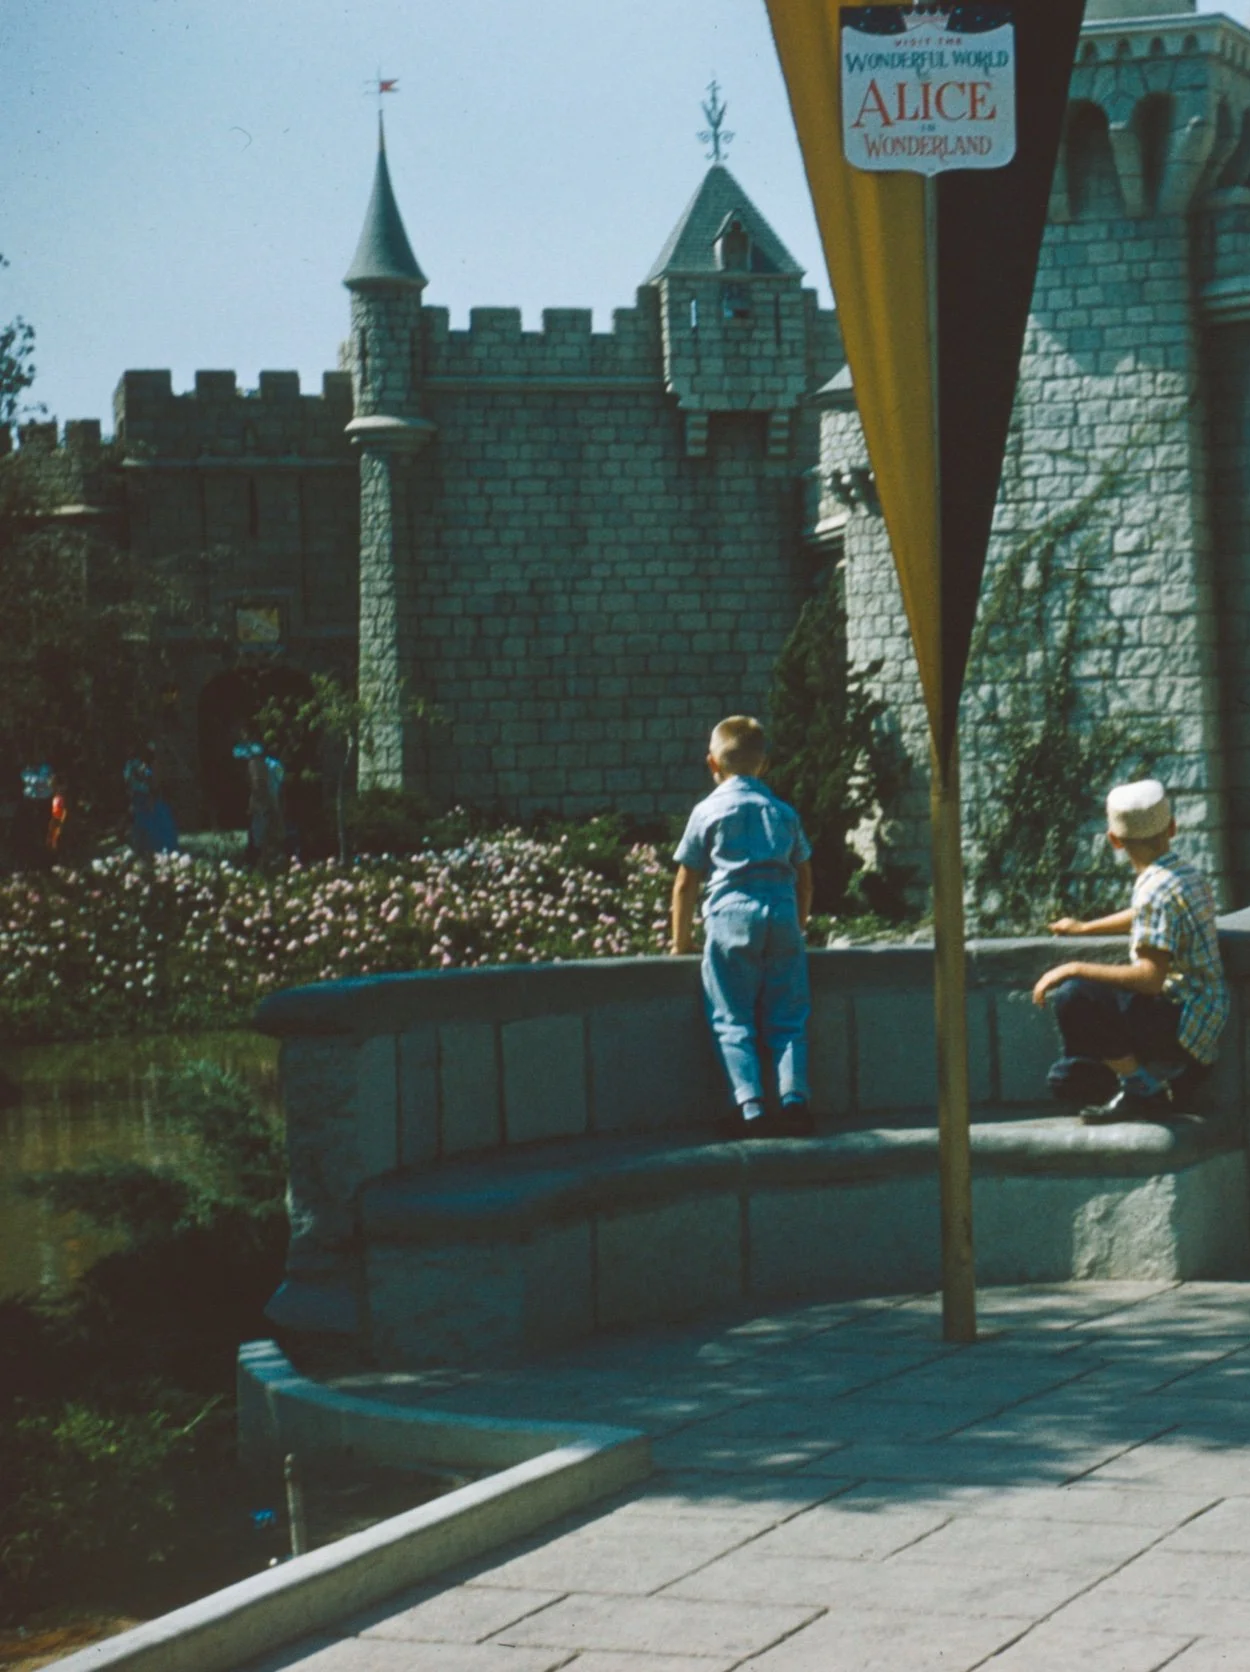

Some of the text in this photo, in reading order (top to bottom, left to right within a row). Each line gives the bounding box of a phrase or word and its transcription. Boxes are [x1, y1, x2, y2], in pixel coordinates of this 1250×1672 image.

[895, 36, 963, 47] VISIT THE
[845, 50, 1010, 79] WONDERFUL WORLD
[852, 78, 998, 129] ALICE
[920, 123, 936, 133] IN
[864, 133, 993, 165] WONDERLAND
